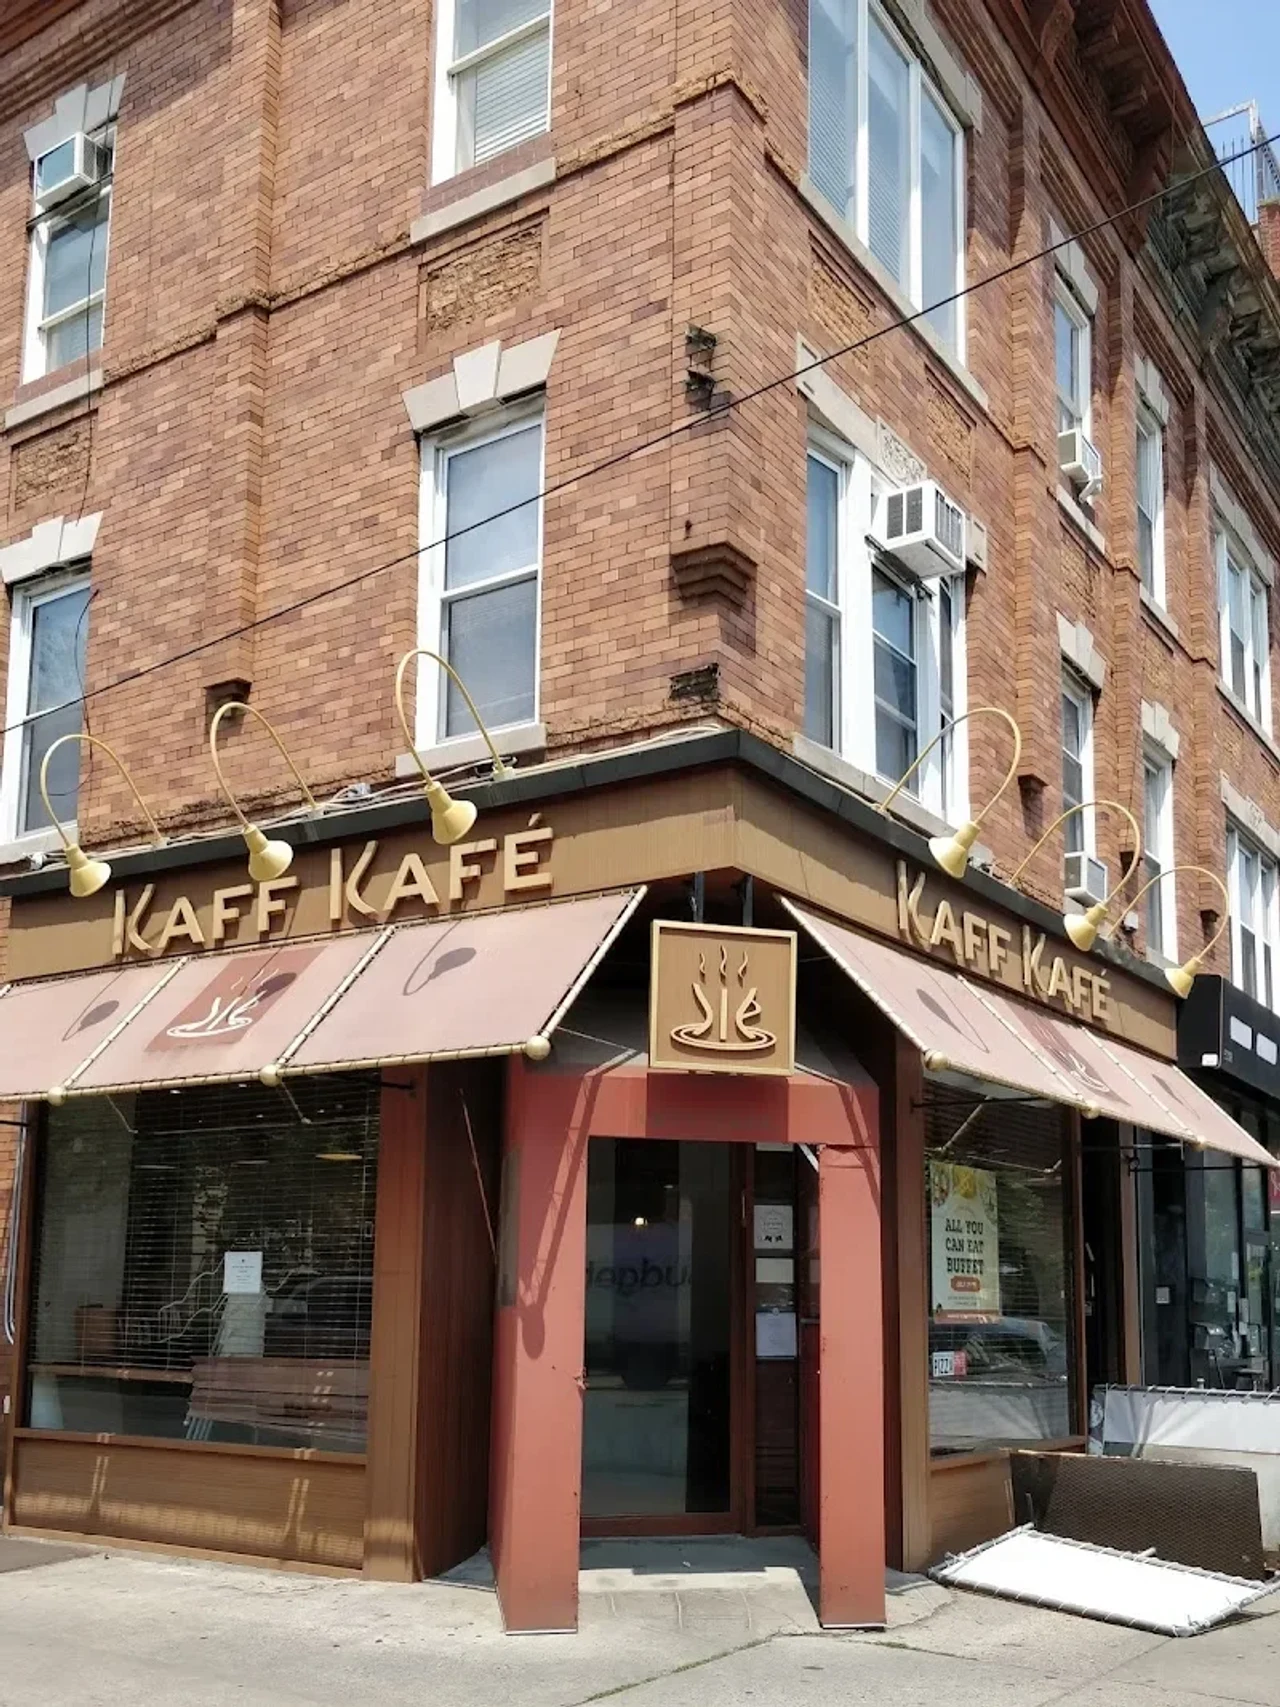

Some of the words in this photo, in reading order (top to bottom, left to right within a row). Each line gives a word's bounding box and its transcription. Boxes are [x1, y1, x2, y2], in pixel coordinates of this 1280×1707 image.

[114, 876, 298, 953] KAFF
[329, 813, 554, 920] KAFÉ
[899, 860, 1011, 970] KAFF
[1023, 925, 1111, 1018] KAFÉ
[945, 1218, 962, 1233] ALL
[966, 1221, 983, 1235] YOU
[946, 1238, 964, 1252] CAN
[967, 1240, 984, 1254] EAT
[947, 1258, 984, 1274] BUFFET
